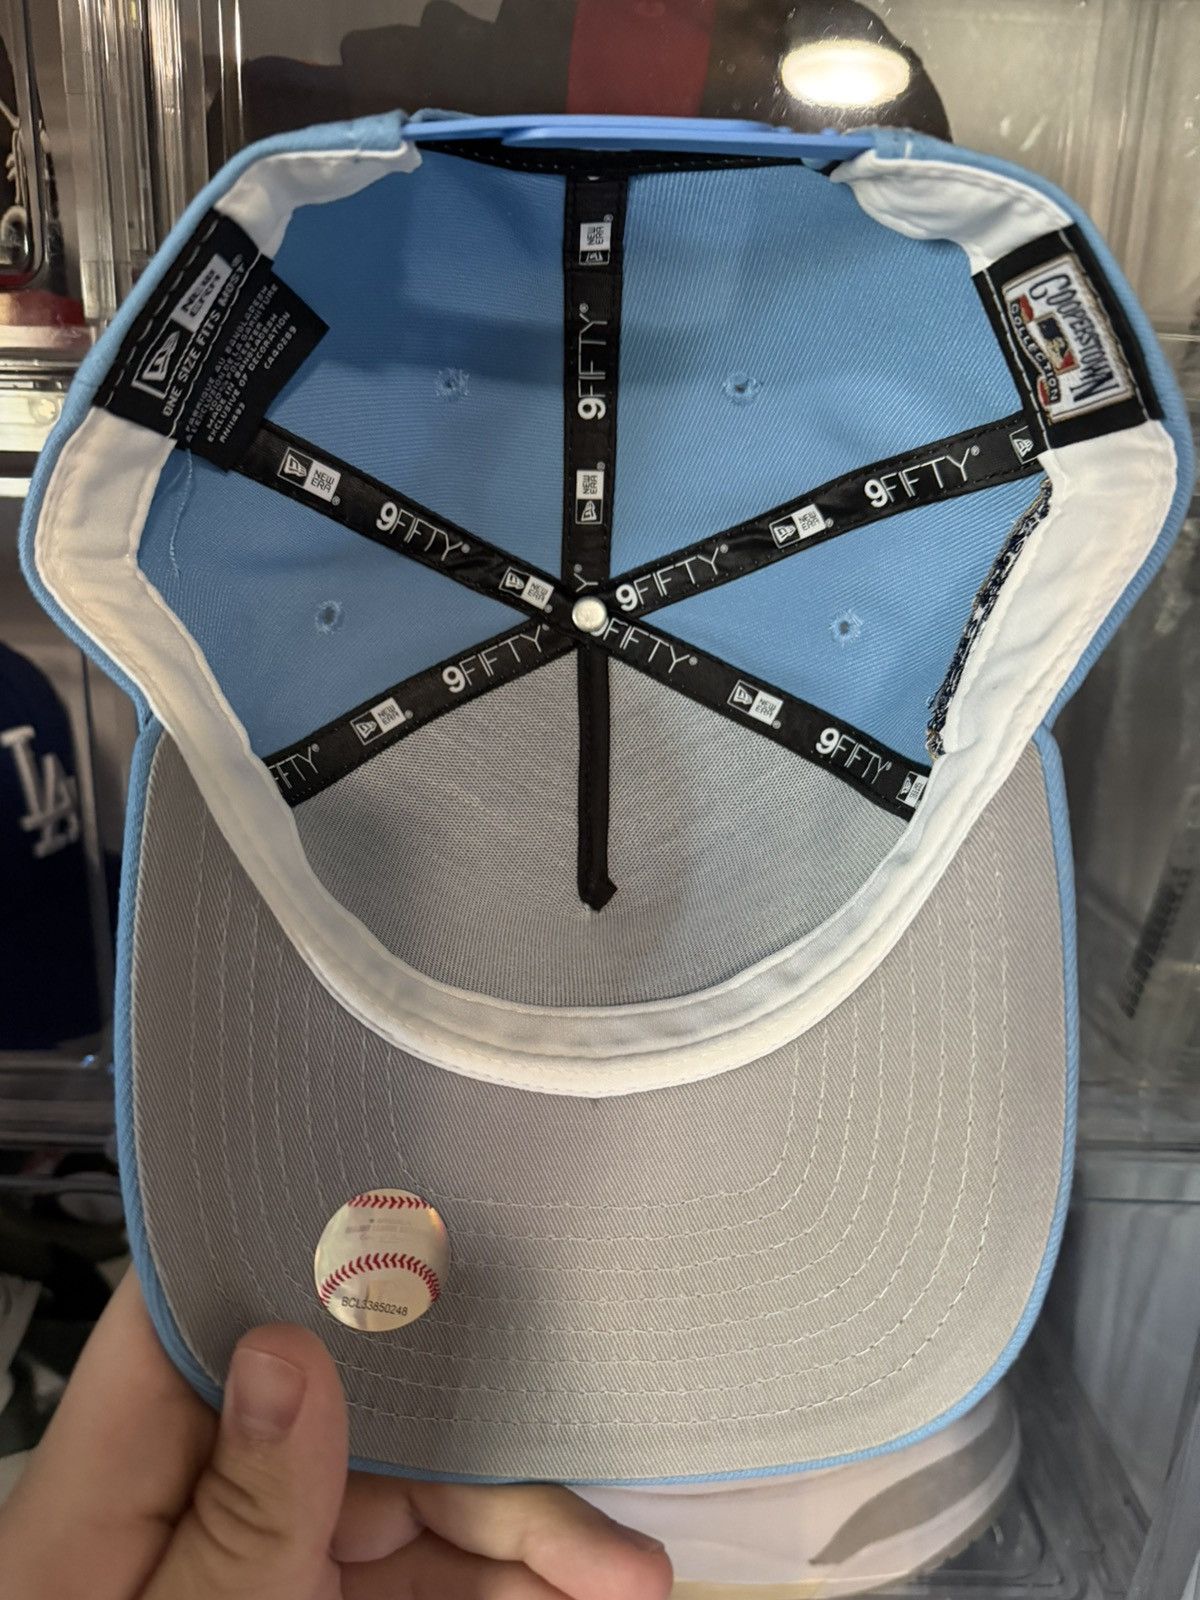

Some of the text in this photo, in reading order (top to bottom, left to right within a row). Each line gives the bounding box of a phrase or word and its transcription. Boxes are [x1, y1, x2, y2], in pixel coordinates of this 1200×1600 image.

[595, 226, 603, 244] ERA
[180, 267, 216, 313] NEW
[188, 271, 222, 318] ERA
[161, 261, 248, 417] ONE SIZE FITS MOST
[213, 357, 226, 373] AU
[223, 284, 269, 354] BANGLADESH
[230, 341, 243, 357] LA
[239, 283, 279, 342] GARNITURE
[1029, 273, 1120, 402] COOPERSTOWN
[205, 312, 278, 429] MADE IN BANGLADESH
[225, 321, 263, 380] POLYESTER
[577, 313, 608, 420] 9FIFTY
[1009, 301, 1060, 402] COLLECTION
[206, 310, 291, 443] EXCLUSIVE OF DECORATION
[309, 476, 332, 493] ERA
[312, 469, 335, 485] NEW
[582, 474, 590, 494] NEW
[589, 474, 597, 494] ERA
[864, 447, 972, 509] 9FIFTY
[376, 502, 463, 561] 9FIFTY
[797, 510, 816, 524] NEW
[800, 516, 819, 531] ERA
[526, 588, 545, 602] ERA
[529, 581, 549, 596] NEW
[615, 547, 720, 612] 9FIFTY
[442, 625, 542, 693] 9FIFTY
[376, 702, 395, 719] NEW
[381, 708, 400, 726] ERA
[754, 704, 774, 718] ERA
[757, 697, 777, 711] NEW
[815, 727, 889, 784] 9FIFTY
[0, 724, 80, 860] LA
[341, 1296, 408, 1317] BCL33850248
